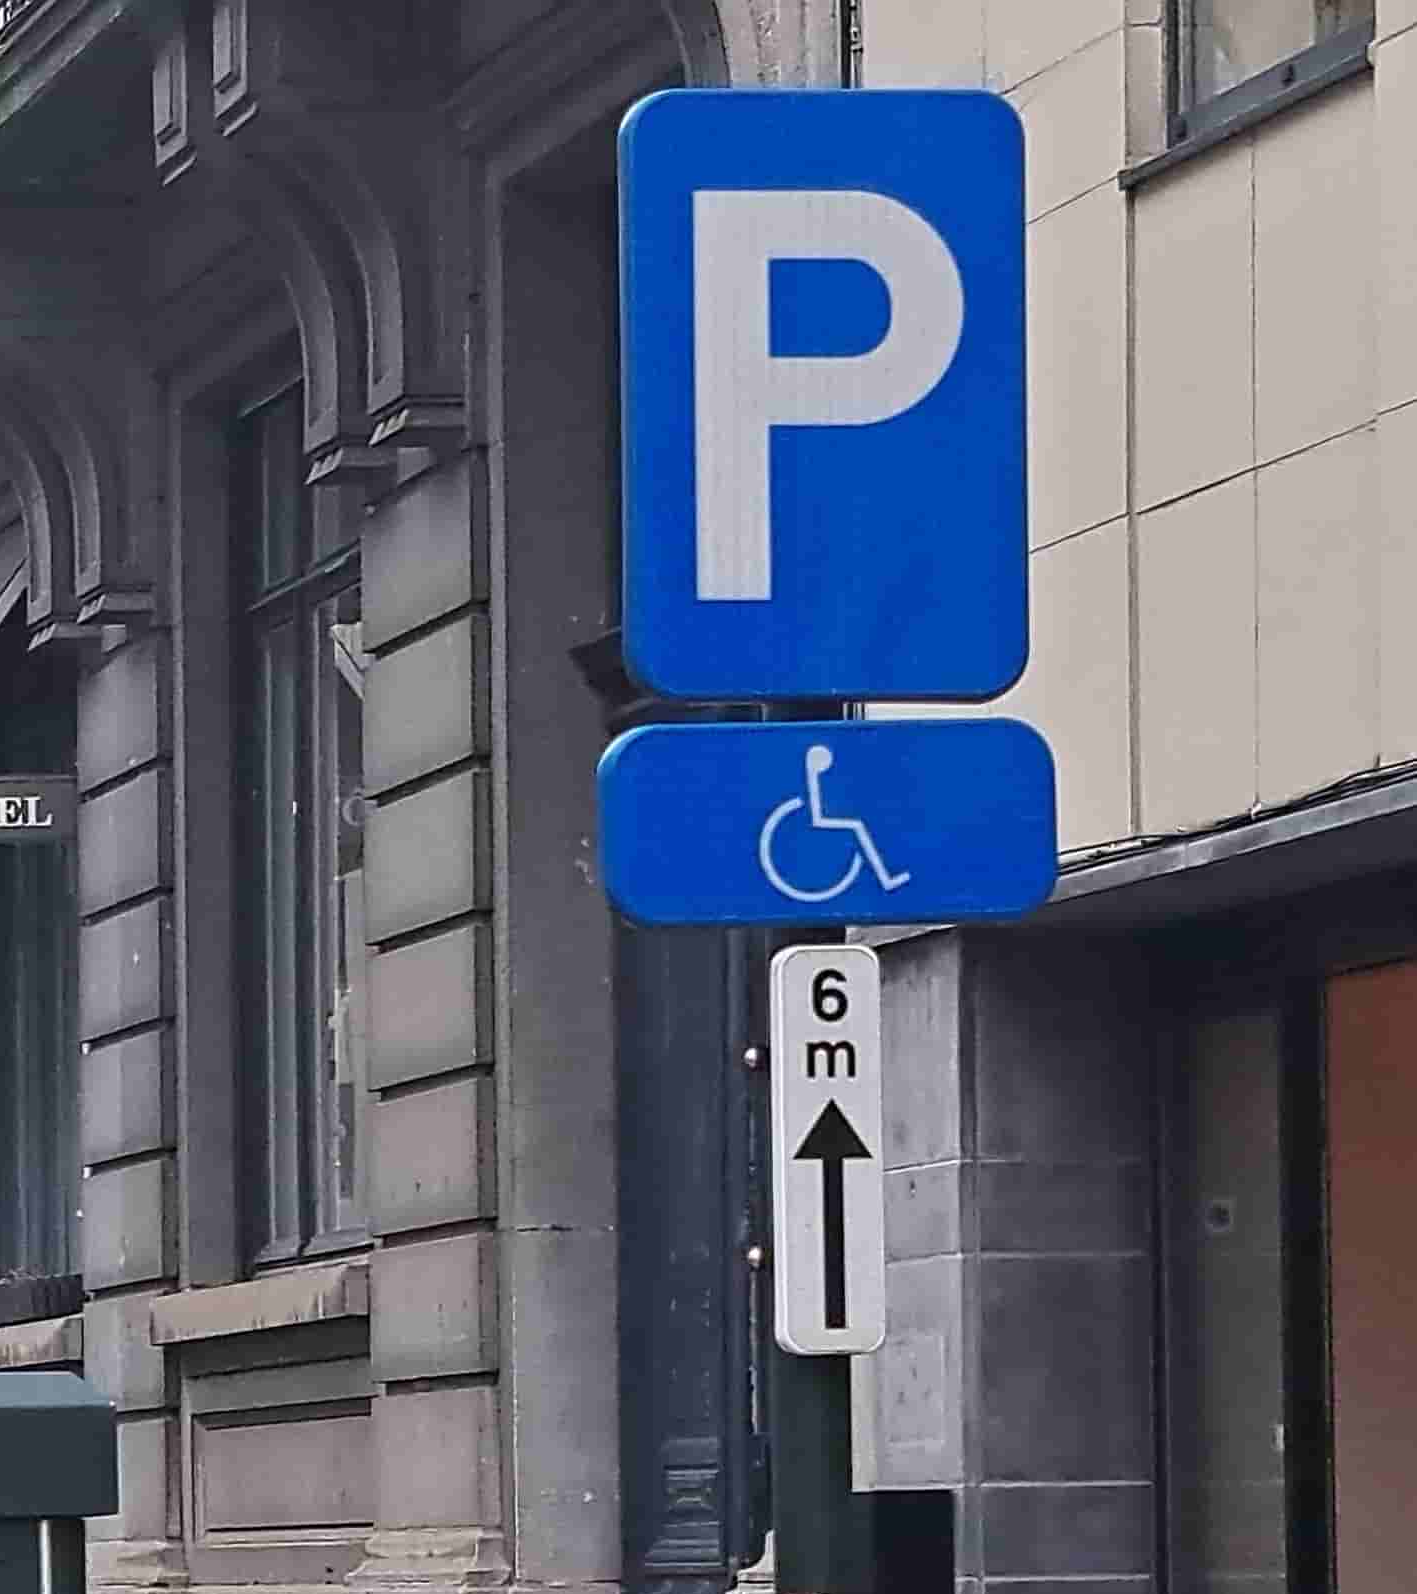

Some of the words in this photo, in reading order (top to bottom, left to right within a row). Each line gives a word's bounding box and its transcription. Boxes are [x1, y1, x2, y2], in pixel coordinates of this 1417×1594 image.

[692, 189, 964, 602] P
[812, 968, 849, 1022] 6
[806, 1040, 856, 1078] m
